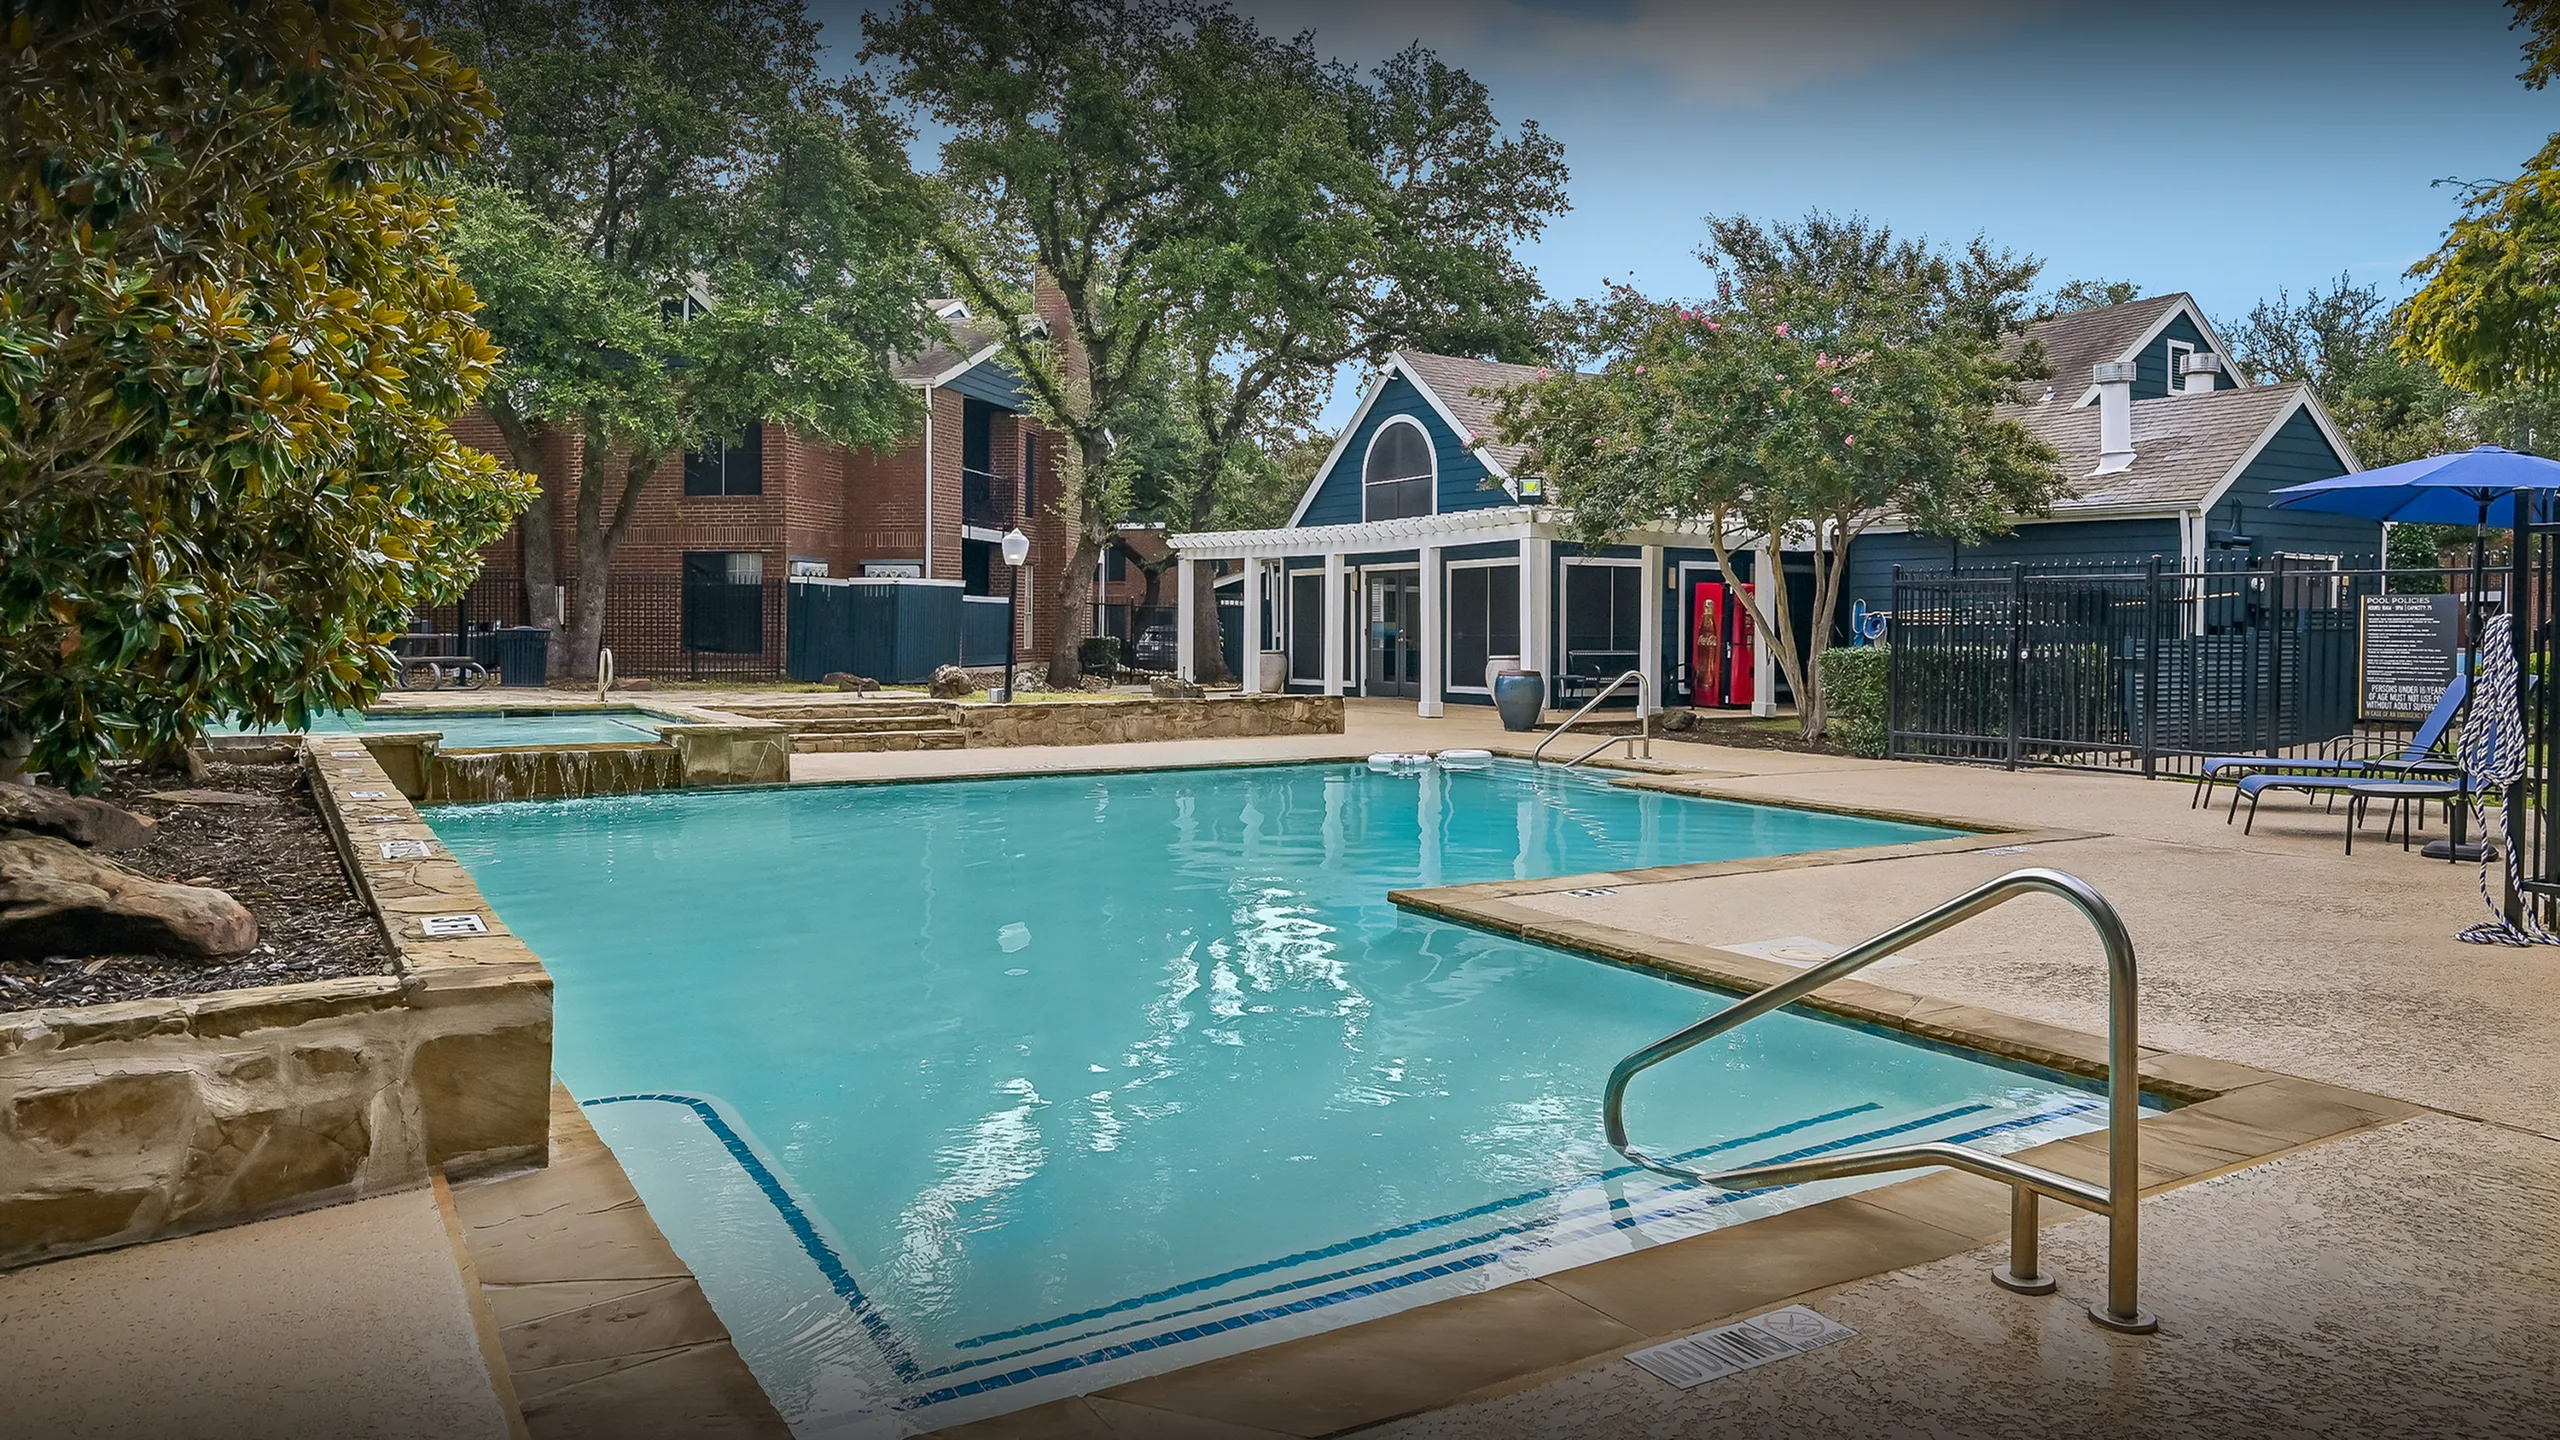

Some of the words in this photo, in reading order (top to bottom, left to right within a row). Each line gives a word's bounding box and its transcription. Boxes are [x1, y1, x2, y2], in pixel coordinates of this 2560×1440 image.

[2372, 685, 2397, 693] PERSONS
[2408, 694, 2419, 702] NOT
[2434, 695, 2442, 703] PO
[2366, 701, 2392, 709] WITHOUT
[2393, 702, 2411, 710] ADULT
[1796, 1341, 1818, 1350] NO
[1812, 1329, 1853, 1344] DIVING
[1635, 1351, 1702, 1384] NO
[1671, 1327, 1789, 1372] DIVING
